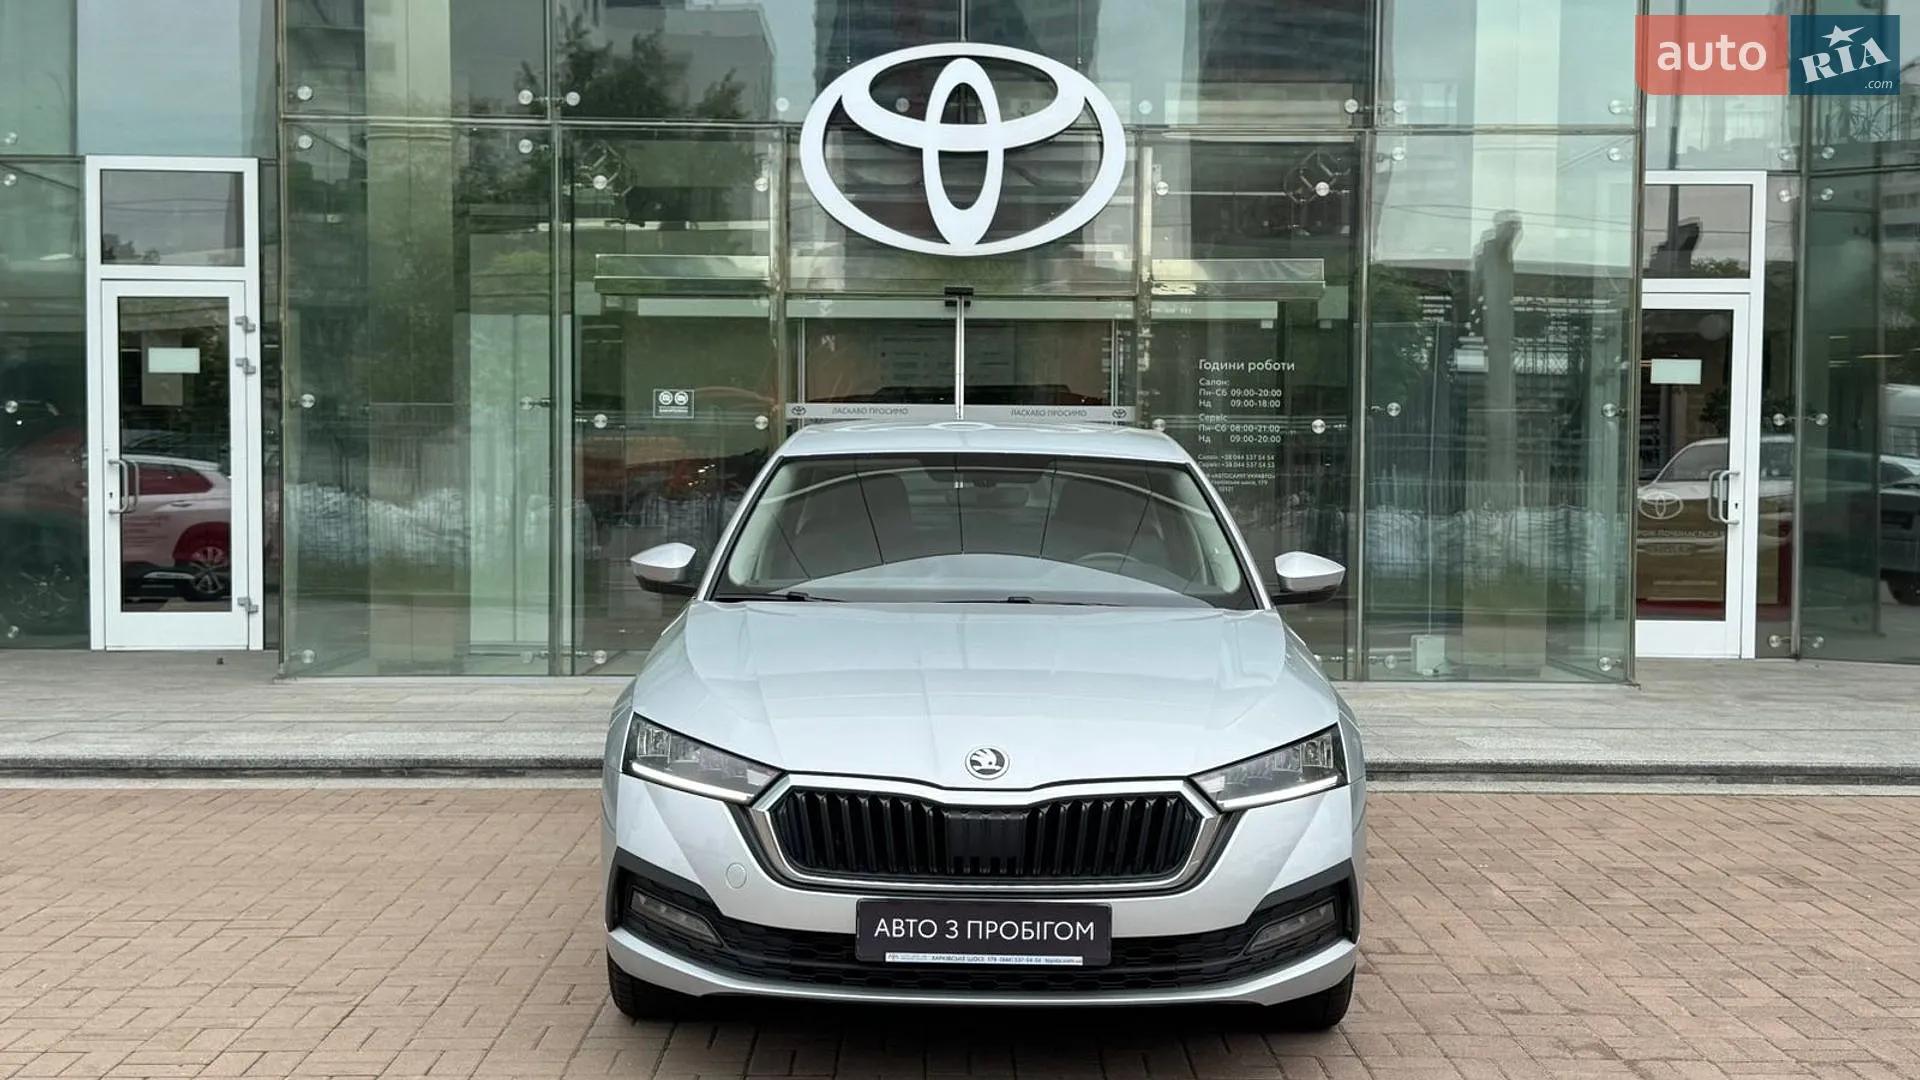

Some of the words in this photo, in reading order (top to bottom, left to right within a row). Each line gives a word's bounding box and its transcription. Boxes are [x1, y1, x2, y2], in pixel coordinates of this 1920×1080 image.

[1198, 359, 1245, 371] Години
[1248, 359, 1295, 373] роботи
[1198, 378, 1230, 386] Салон:
[1198, 388, 1228, 397] Пн-Сб
[1230, 388, 1282, 397] 09:00-20:00
[1198, 399, 1212, 409] Нд
[1230, 399, 1281, 409] 09:00-18:00
[832, 407, 868, 416] ЛАСКАВО
[869, 407, 909, 416] ПРОСИМО
[1010, 409, 1046, 417] ЛАСКАВО
[1047, 409, 1087, 418] ПРОСИМО
[1198, 424, 1227, 433] Пн-Сб
[1229, 424, 1281, 433] 08:00-21:00
[1198, 434, 1212, 444] Нд
[1229, 434, 1282, 443] 09:00-20:00
[873, 918, 938, 939] АВТО
[967, 920, 1094, 941] ПРОБІГОМ
